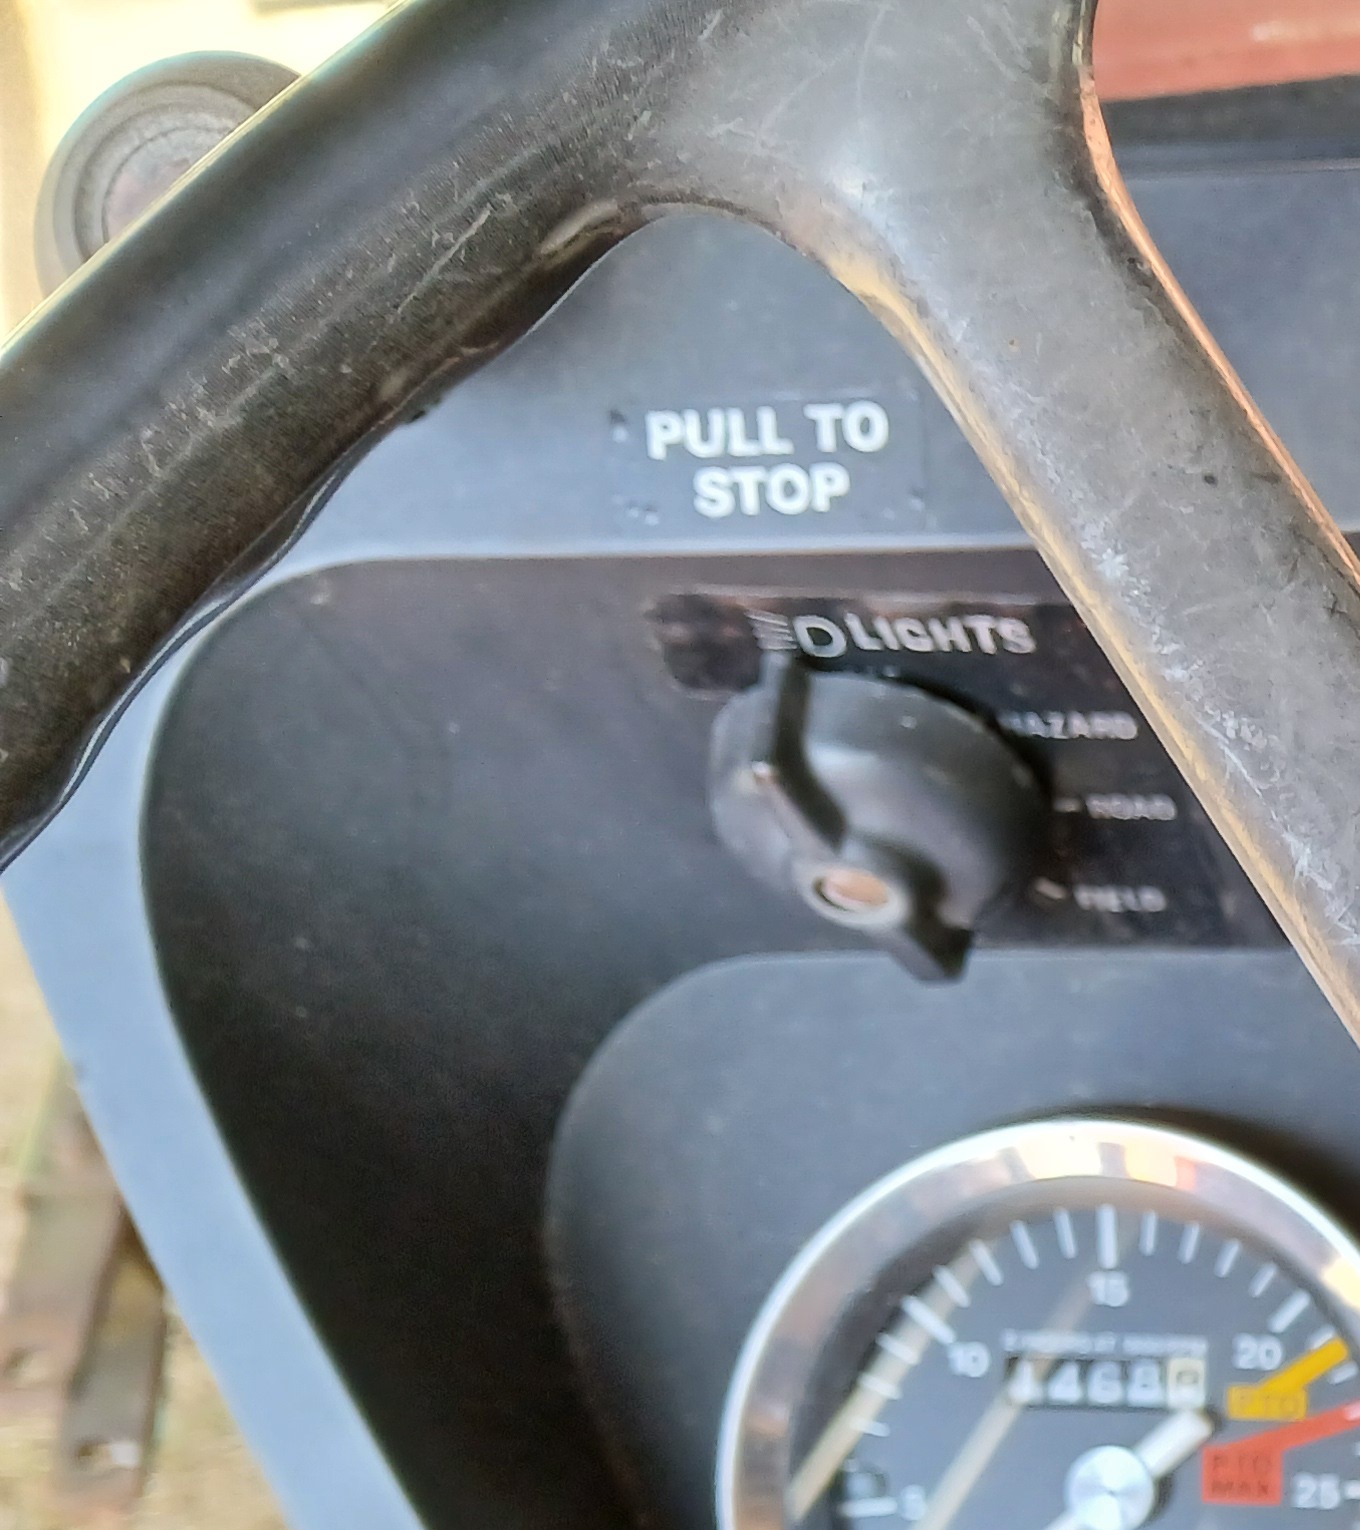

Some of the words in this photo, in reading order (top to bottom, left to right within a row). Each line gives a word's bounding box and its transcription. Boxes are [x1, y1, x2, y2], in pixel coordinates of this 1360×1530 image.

[645, 406, 793, 461] PULL
[805, 400, 891, 453] TO
[692, 463, 852, 519] STOP
[845, 612, 1037, 656] LIGHTS
[1086, 1270, 1130, 1307] 15
[950, 1344, 991, 1379] 10
[1232, 1333, 1284, 1371] 20
[1293, 1472, 1341, 1510] 25
